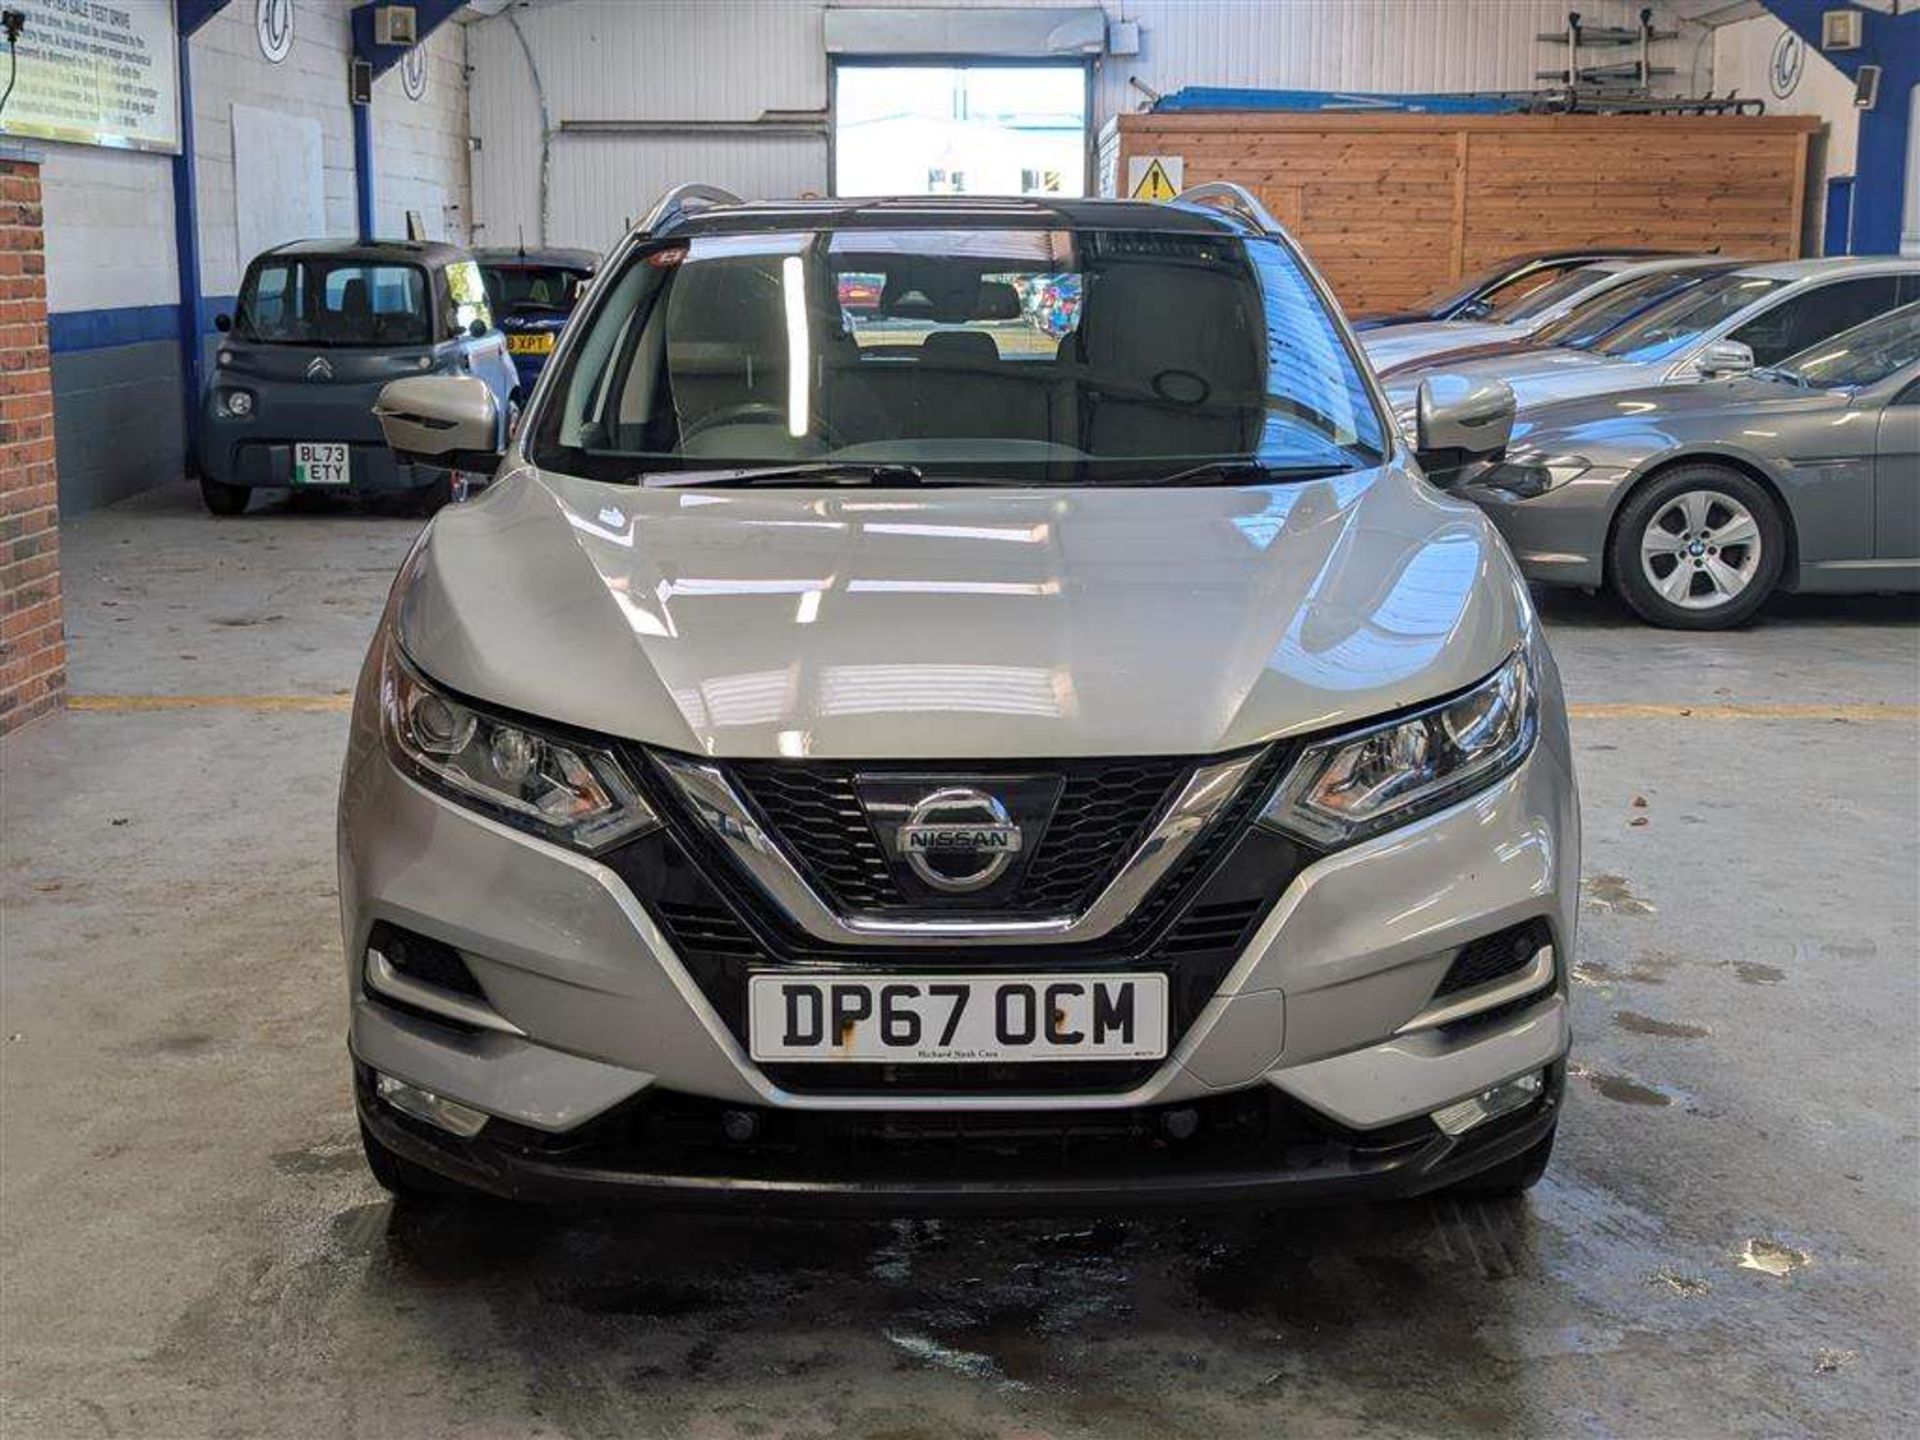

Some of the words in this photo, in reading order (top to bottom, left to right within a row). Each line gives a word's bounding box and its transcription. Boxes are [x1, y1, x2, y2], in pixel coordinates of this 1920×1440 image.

[90, 3, 109, 22] TEST
[109, 8, 130, 30] DRIVE
[301, 446, 345, 462] BL73
[310, 464, 343, 480] ETY
[910, 831, 1008, 846] NISSAN
[782, 984, 970, 1047] DP67
[995, 982, 1135, 1046] OCM
